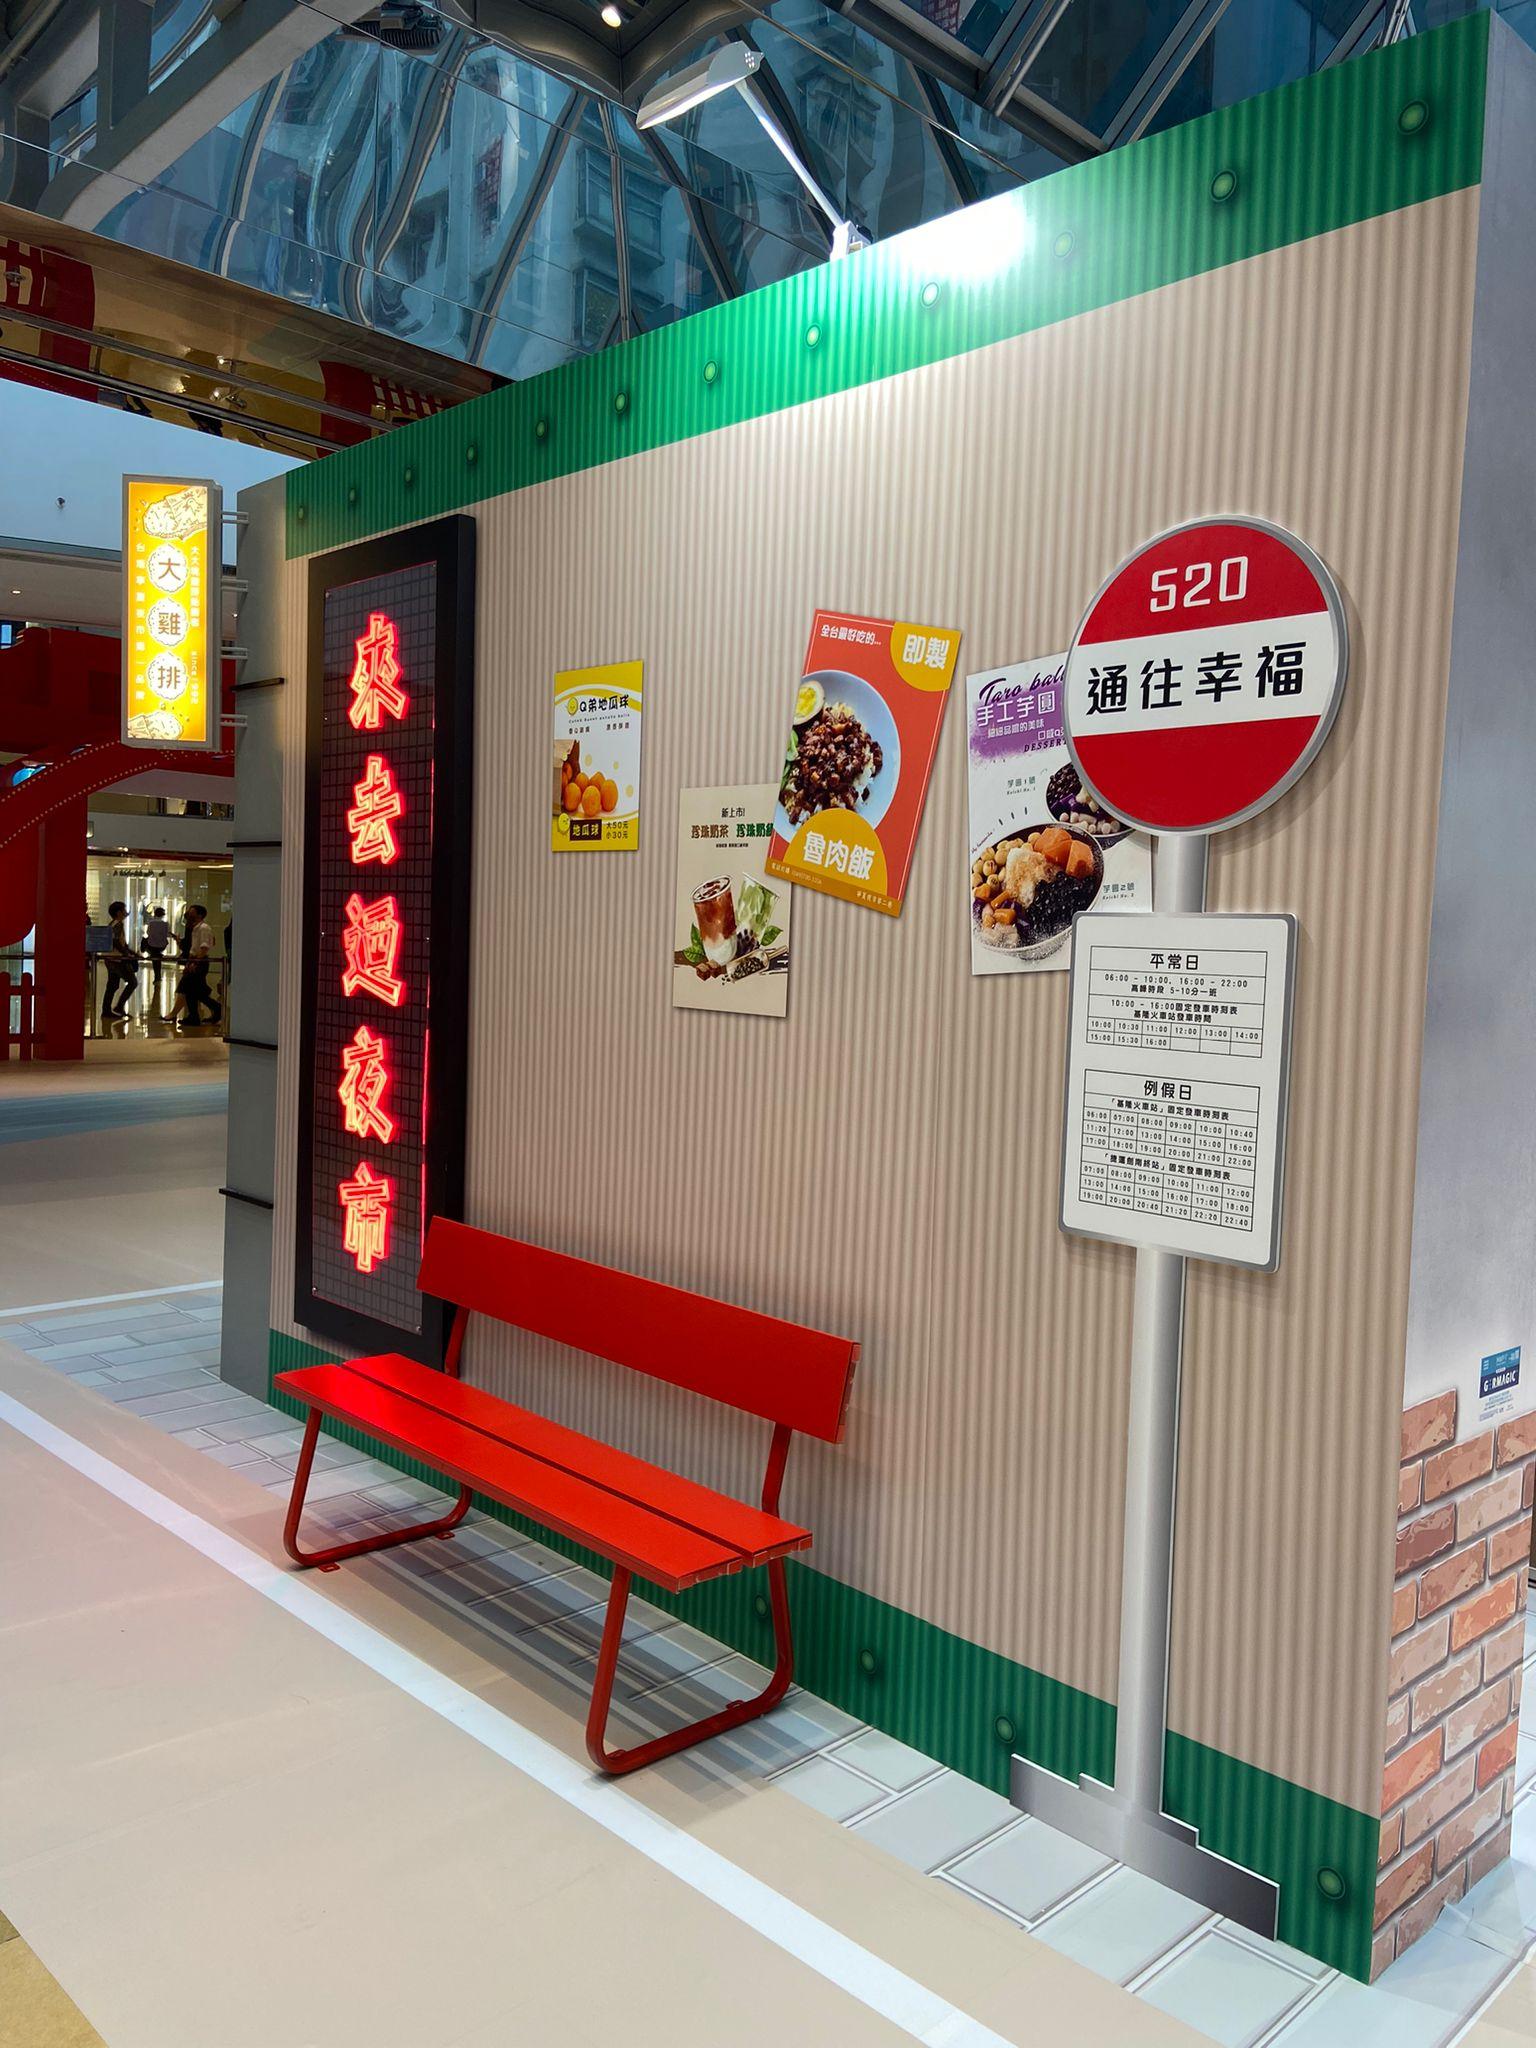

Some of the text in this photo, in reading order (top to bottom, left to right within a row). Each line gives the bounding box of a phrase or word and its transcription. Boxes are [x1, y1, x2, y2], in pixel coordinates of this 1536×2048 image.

[1149, 555, 1249, 613] 520
[157, 556, 183, 690] 大雞排
[903, 633, 950, 670] 即製
[979, 678, 1022, 706] Taro
[1085, 641, 1307, 716] 通往幸福
[976, 691, 1055, 727] 手工芋圓
[691, 824, 729, 839] 珍珠奶茶
[803, 831, 876, 881] 魯肉飯
[1150, 953, 1199, 970] 平常日
[1105, 973, 1129, 982] 06:00
[1179, 977, 1205, 986] 16:00
[1221, 979, 1248, 988] 22:00
[1111, 999, 1135, 1008] 10:00
[1091, 1021, 1259, 1040] 10:00 10:30 11:00 12:00 13:00 14:00
[1145, 1038, 1167, 1046] 16:00
[1144, 1080, 1193, 1100] 例假日
[1086, 1124, 1253, 1153] 11:20 12:00 13:00 14:00 15:00 16:00
[1113, 1114, 1135, 1123] 07:00
[1169, 1121, 1192, 1130] 09:00
[1199, 1125, 1222, 1134] 10:00
[1230, 1129, 1254, 1138] 10:40
[1086, 1137, 1252, 1166] 17:00 18:00 19:00 20:00 21:00 22:00
[1083, 1179, 1249, 1212] 13:00 14:00 15:00 16:00 17:00 18:00
[1084, 1166, 1250, 1198] 07:00 08:00 09:00 10:00 11:00 12:00
[1083, 1192, 1249, 1226] 19:00 20:00 20:40 21:20 22:20 22:40
